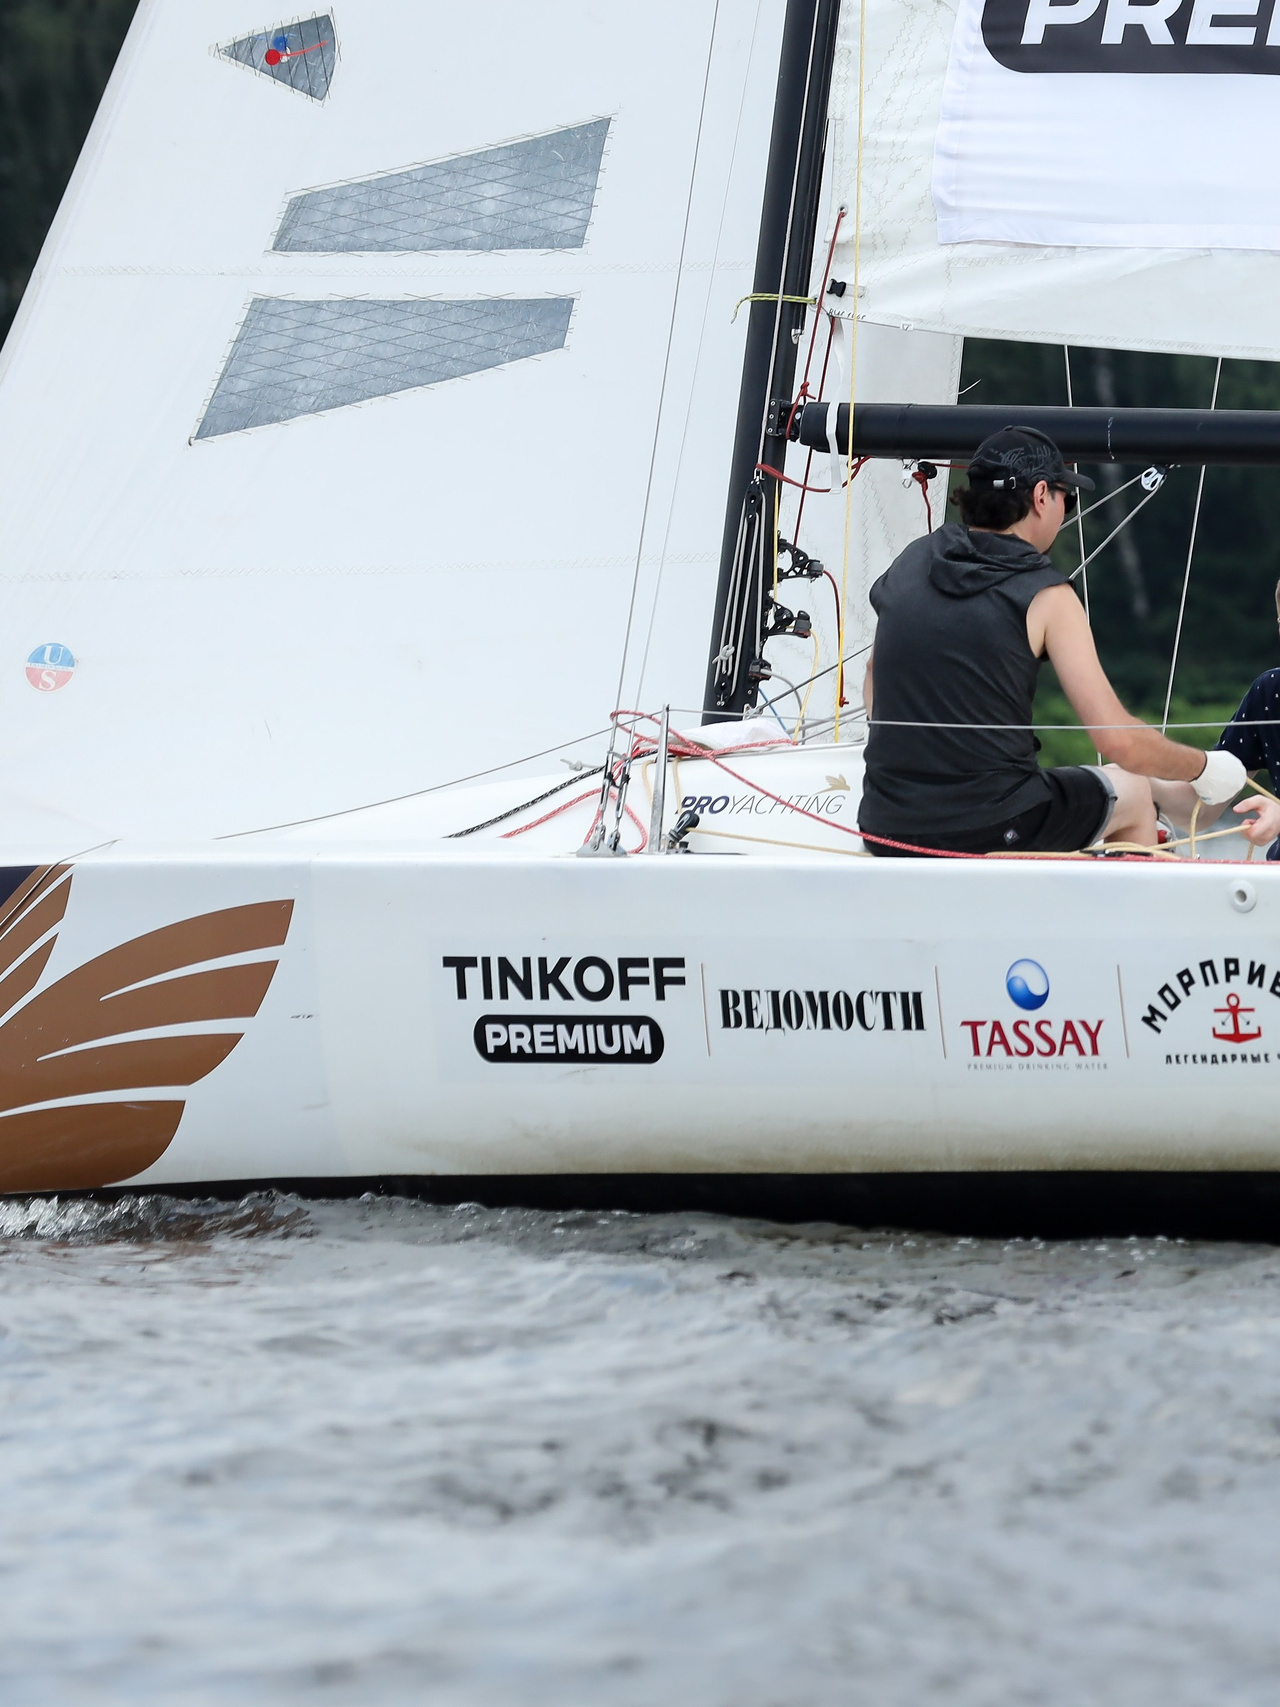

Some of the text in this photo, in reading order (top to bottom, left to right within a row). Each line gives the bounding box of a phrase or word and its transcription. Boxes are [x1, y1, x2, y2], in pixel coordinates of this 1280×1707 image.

[442, 955, 686, 1002] TINKOFF
[718, 988, 926, 1035] ВЕДОМОСТИ
[484, 1023, 652, 1055] PREMIUM
[960, 1019, 1104, 1057] TASSAY
[1165, 1053, 1270, 1065] ЛЕГЕНДАРНЫЕ
